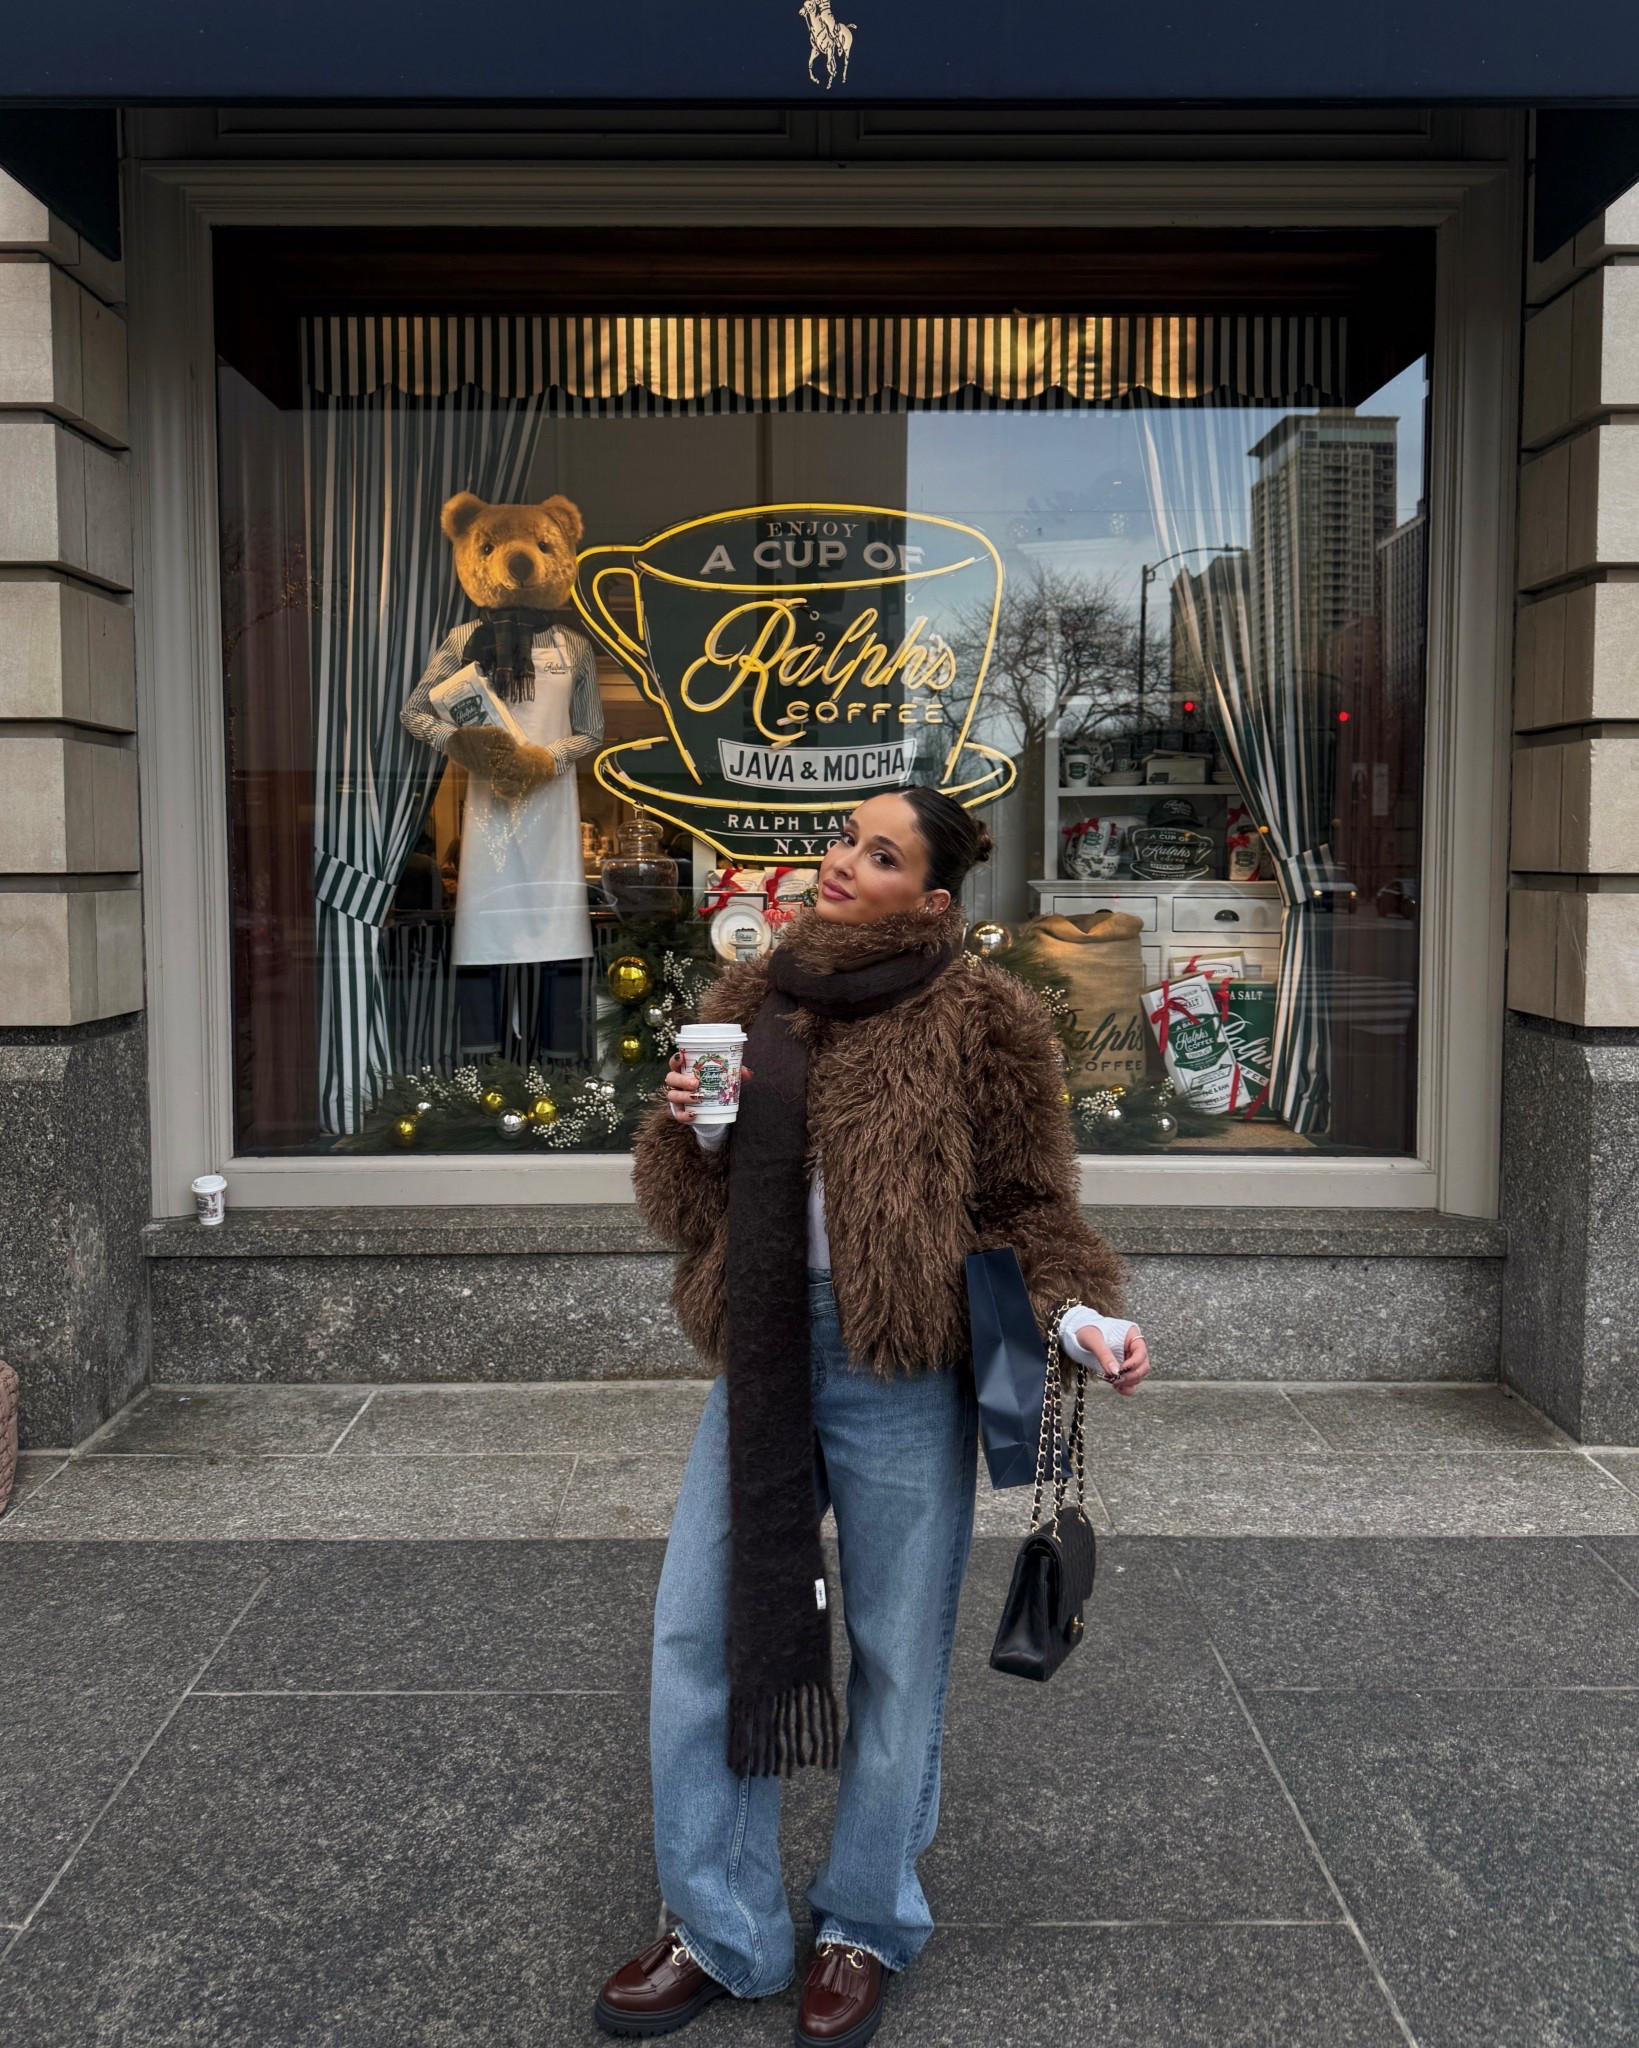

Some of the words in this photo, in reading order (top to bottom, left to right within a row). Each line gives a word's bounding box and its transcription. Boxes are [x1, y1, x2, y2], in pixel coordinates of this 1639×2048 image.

[767, 521, 859, 538] ENJOY
[699, 544, 736, 575] A
[753, 540, 848, 569] CUP
[863, 541, 925, 573] OF
[680, 597, 957, 743] Ralph's
[786, 700, 944, 724] COFFEE
[729, 750, 794, 783] JAVA
[800, 760, 819, 781] &
[823, 747, 906, 782] MOCHA
[728, 814, 799, 831] RALPH
[1237, 991, 1263, 1001] SALT
[1175, 1028, 1209, 1052] Ralph's
[1187, 1038, 1215, 1051] COFFEE
[1079, 1060, 1142, 1072] OFFEE
[1240, 1067, 1267, 1084] FFEE
